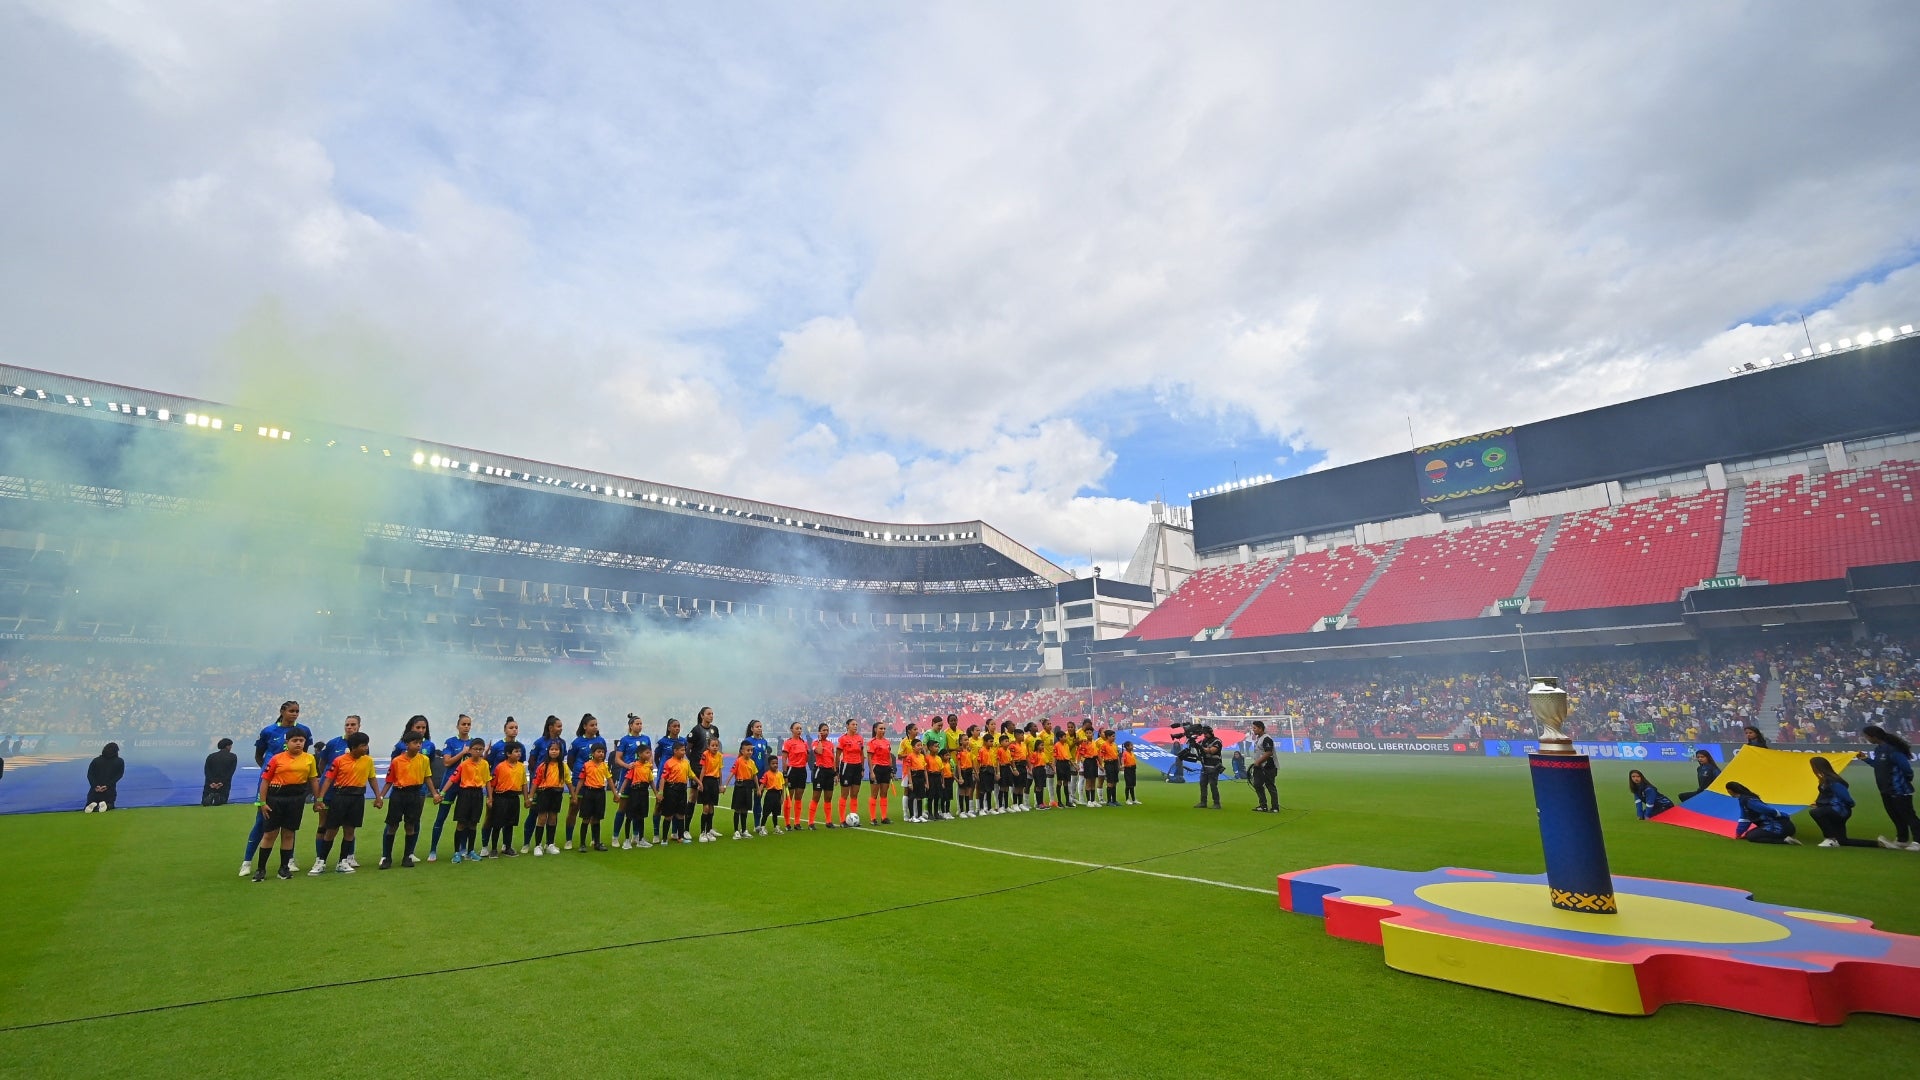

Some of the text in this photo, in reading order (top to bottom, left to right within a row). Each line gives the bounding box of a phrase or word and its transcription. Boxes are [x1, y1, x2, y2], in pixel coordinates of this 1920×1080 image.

[1455, 459, 1474, 468] VS
[1498, 599, 1525, 608] SALID
[1325, 741, 1450, 752] CONMEBOL LIBERTADORES
